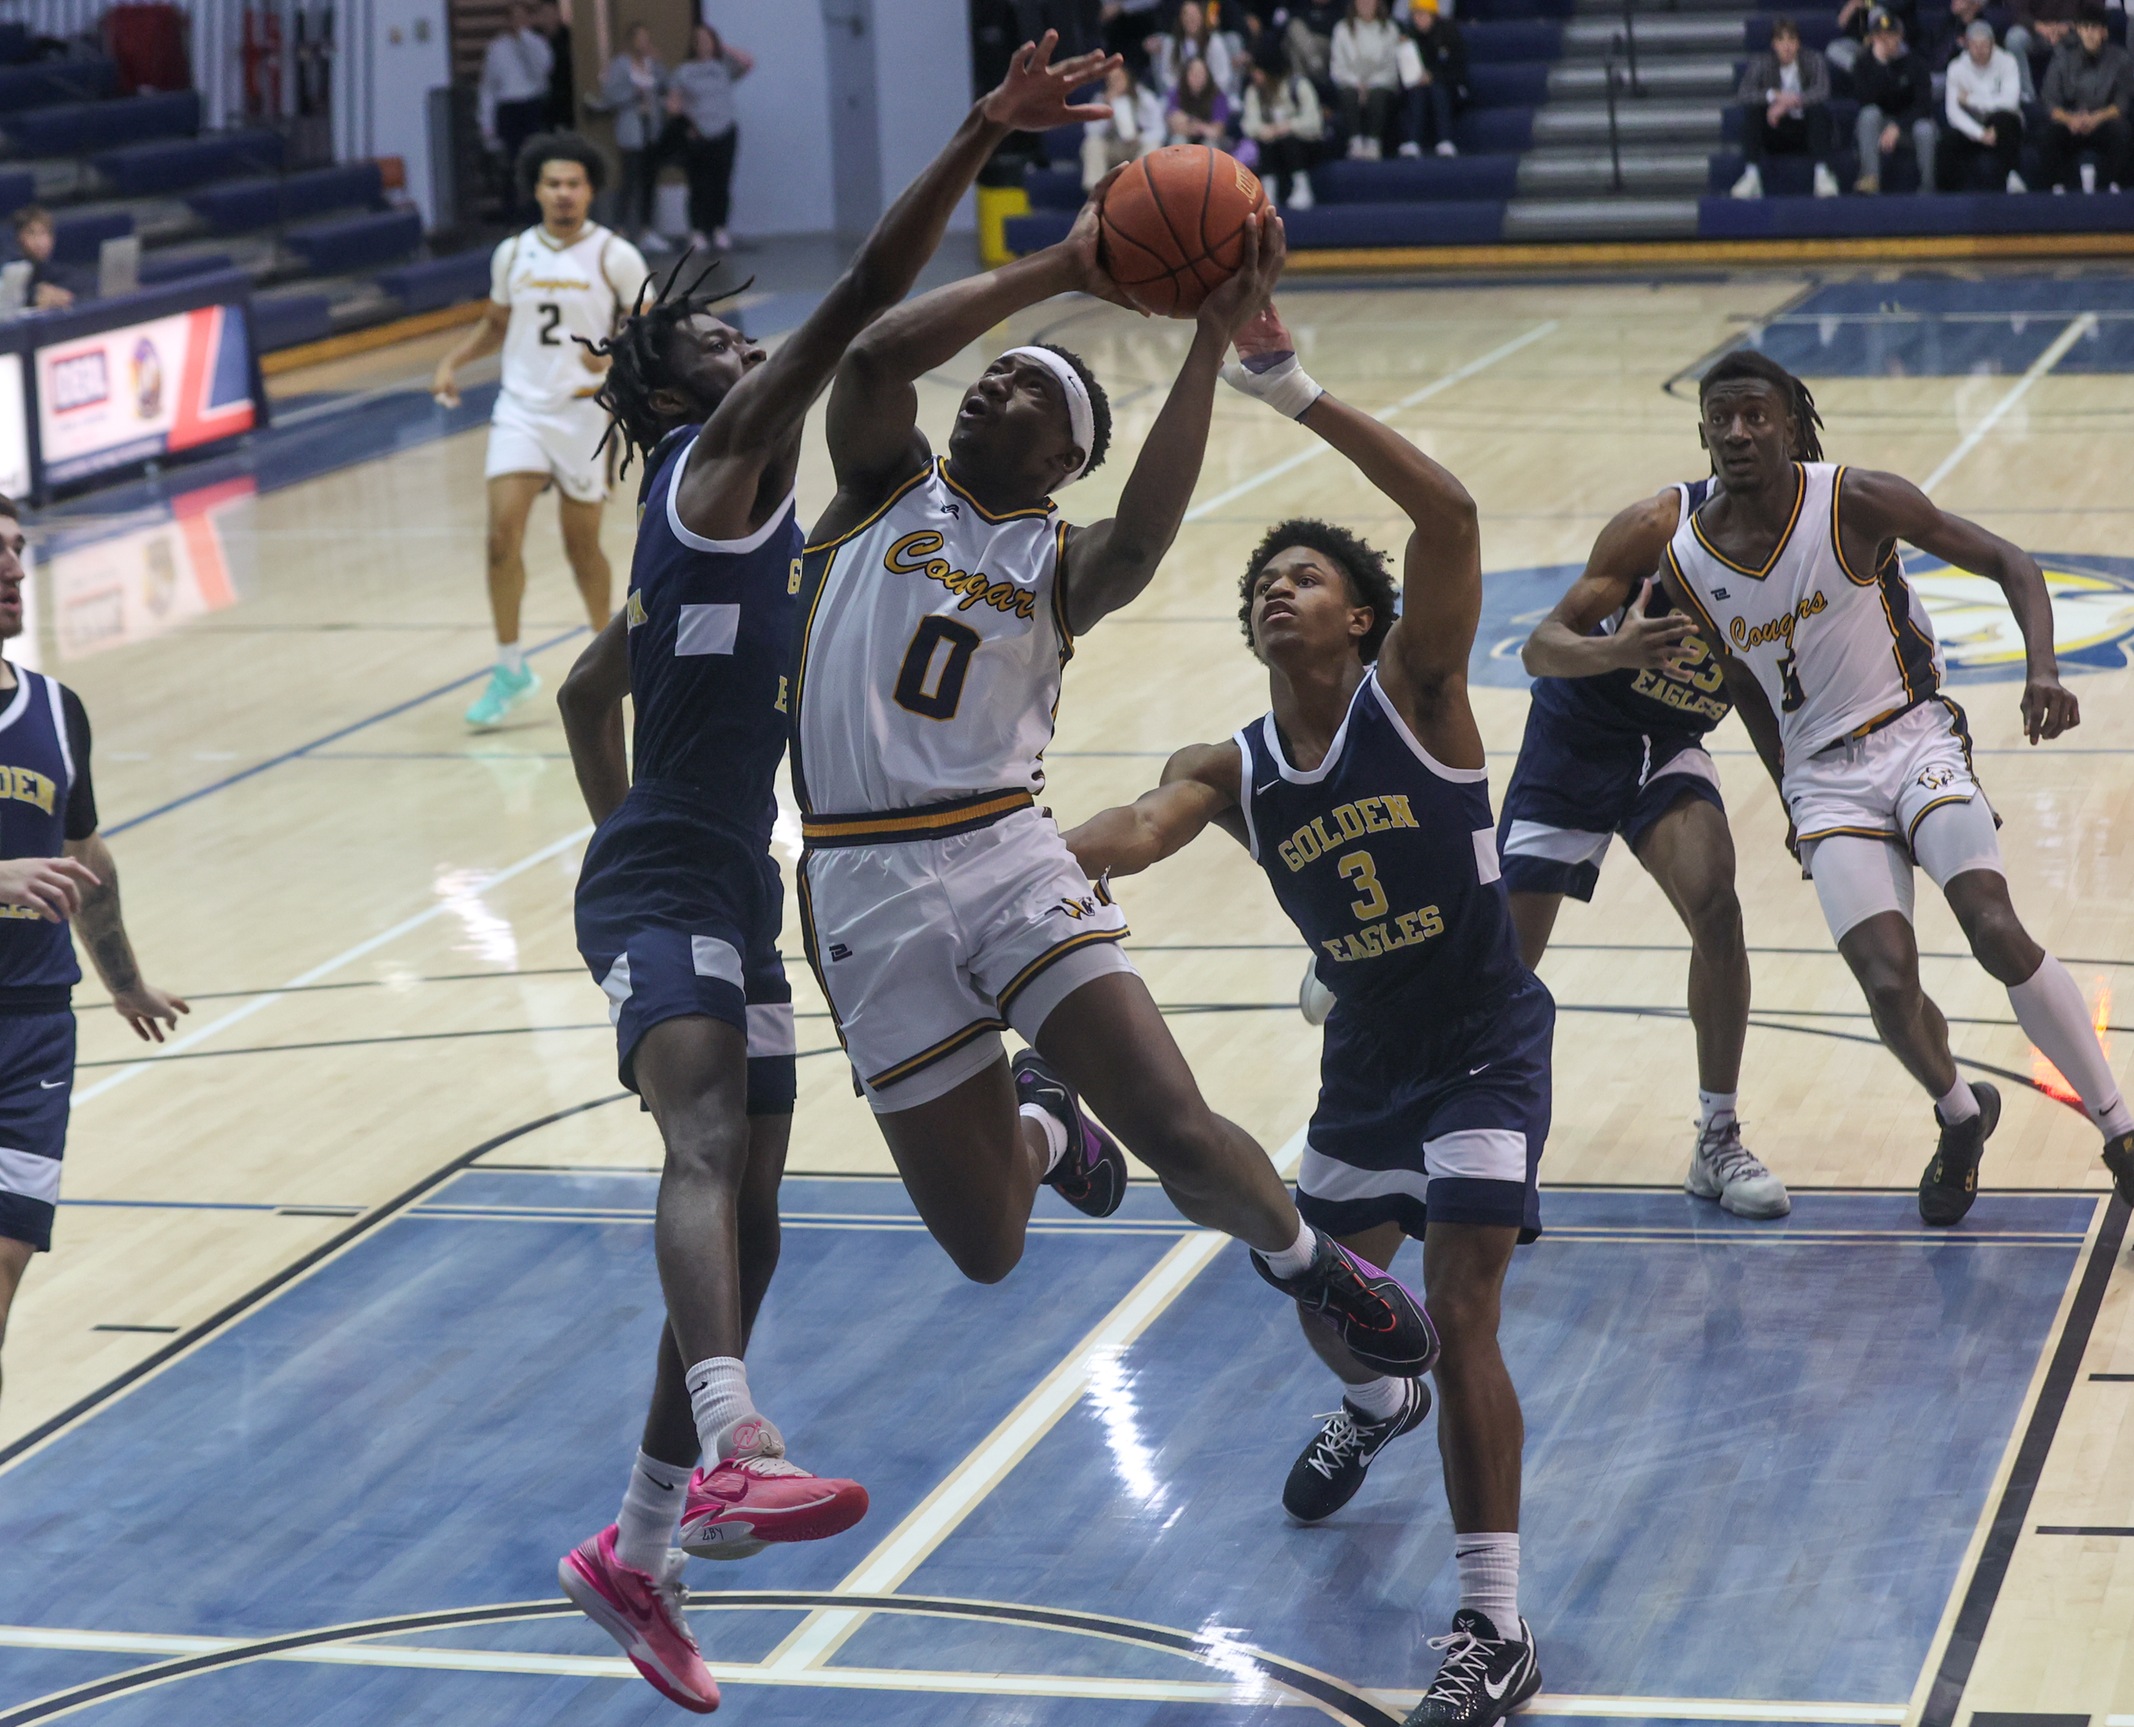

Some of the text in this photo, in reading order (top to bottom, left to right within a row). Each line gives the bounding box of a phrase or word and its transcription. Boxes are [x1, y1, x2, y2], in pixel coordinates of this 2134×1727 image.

[538, 303, 561, 345] 2
[884, 530, 1035, 621] Cougar
[1730, 591, 1828, 652] Cougrs
[892, 614, 982, 722] 0
[1631, 668, 1728, 721] EAGLES
[1278, 795, 1420, 872] GOLDEN
[1337, 850, 1389, 921] 3
[1321, 905, 1444, 962] EAGLES
